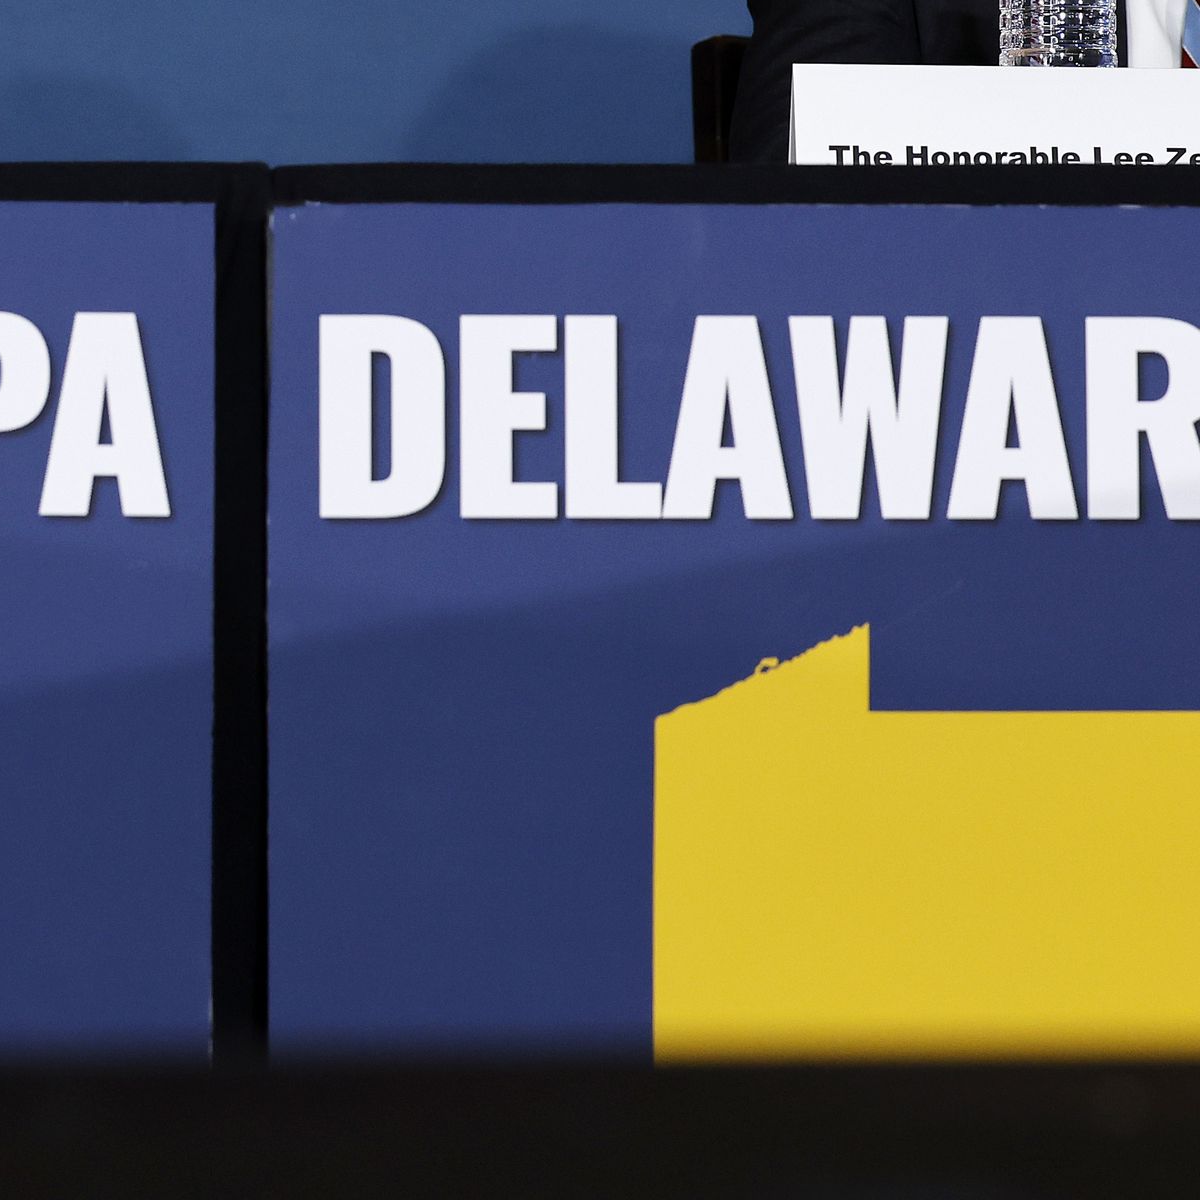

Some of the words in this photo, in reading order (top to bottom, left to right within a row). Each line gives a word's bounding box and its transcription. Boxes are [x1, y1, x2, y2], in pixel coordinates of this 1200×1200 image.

[828, 145, 894, 165] The
[905, 145, 1081, 165] Honorable
[1093, 146, 1155, 165] Lee
[318, 314, 1200, 520] DELAWAR
